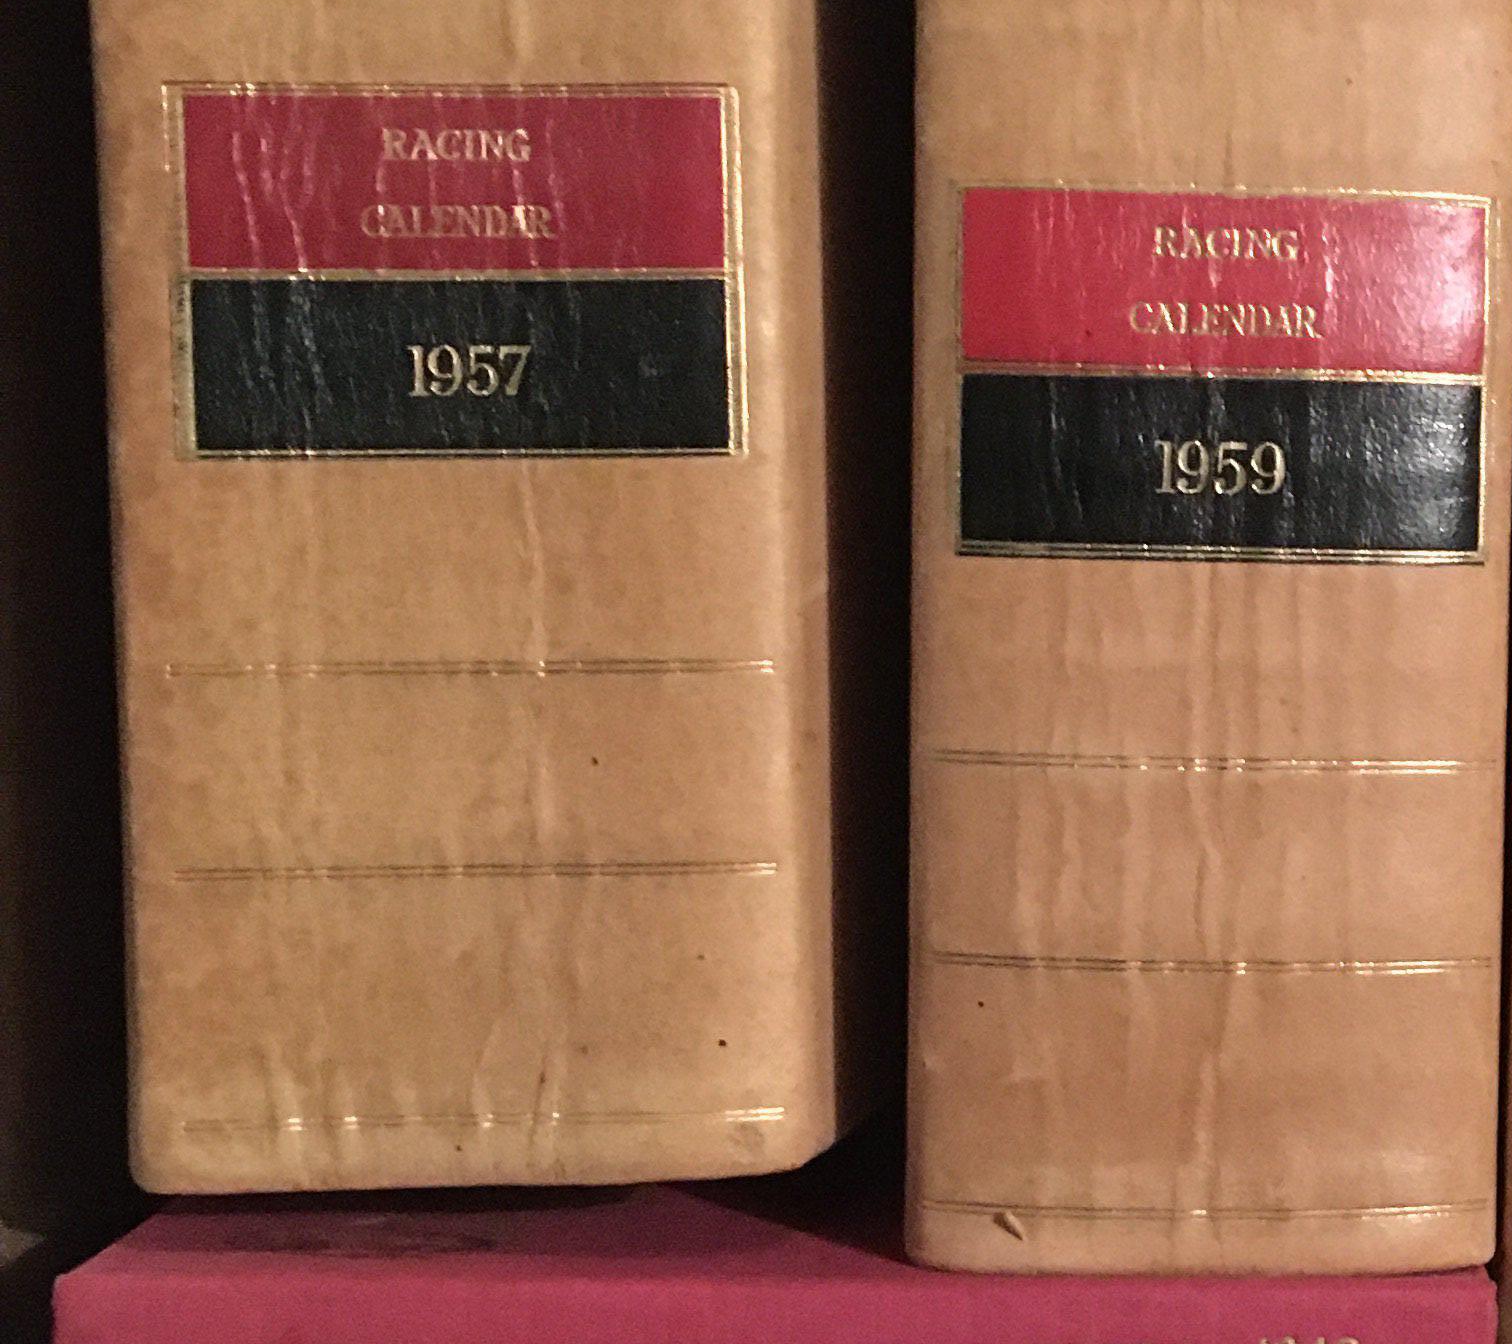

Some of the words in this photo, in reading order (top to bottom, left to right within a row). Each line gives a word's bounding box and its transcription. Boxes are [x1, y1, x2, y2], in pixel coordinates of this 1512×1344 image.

[381, 128, 533, 164] RACING
[359, 203, 557, 243] CALENDAR
[1152, 226, 1301, 264] RACING
[1128, 301, 1323, 342] CALENDAR
[403, 346, 535, 399] 1957
[1153, 439, 1287, 497] 1959
